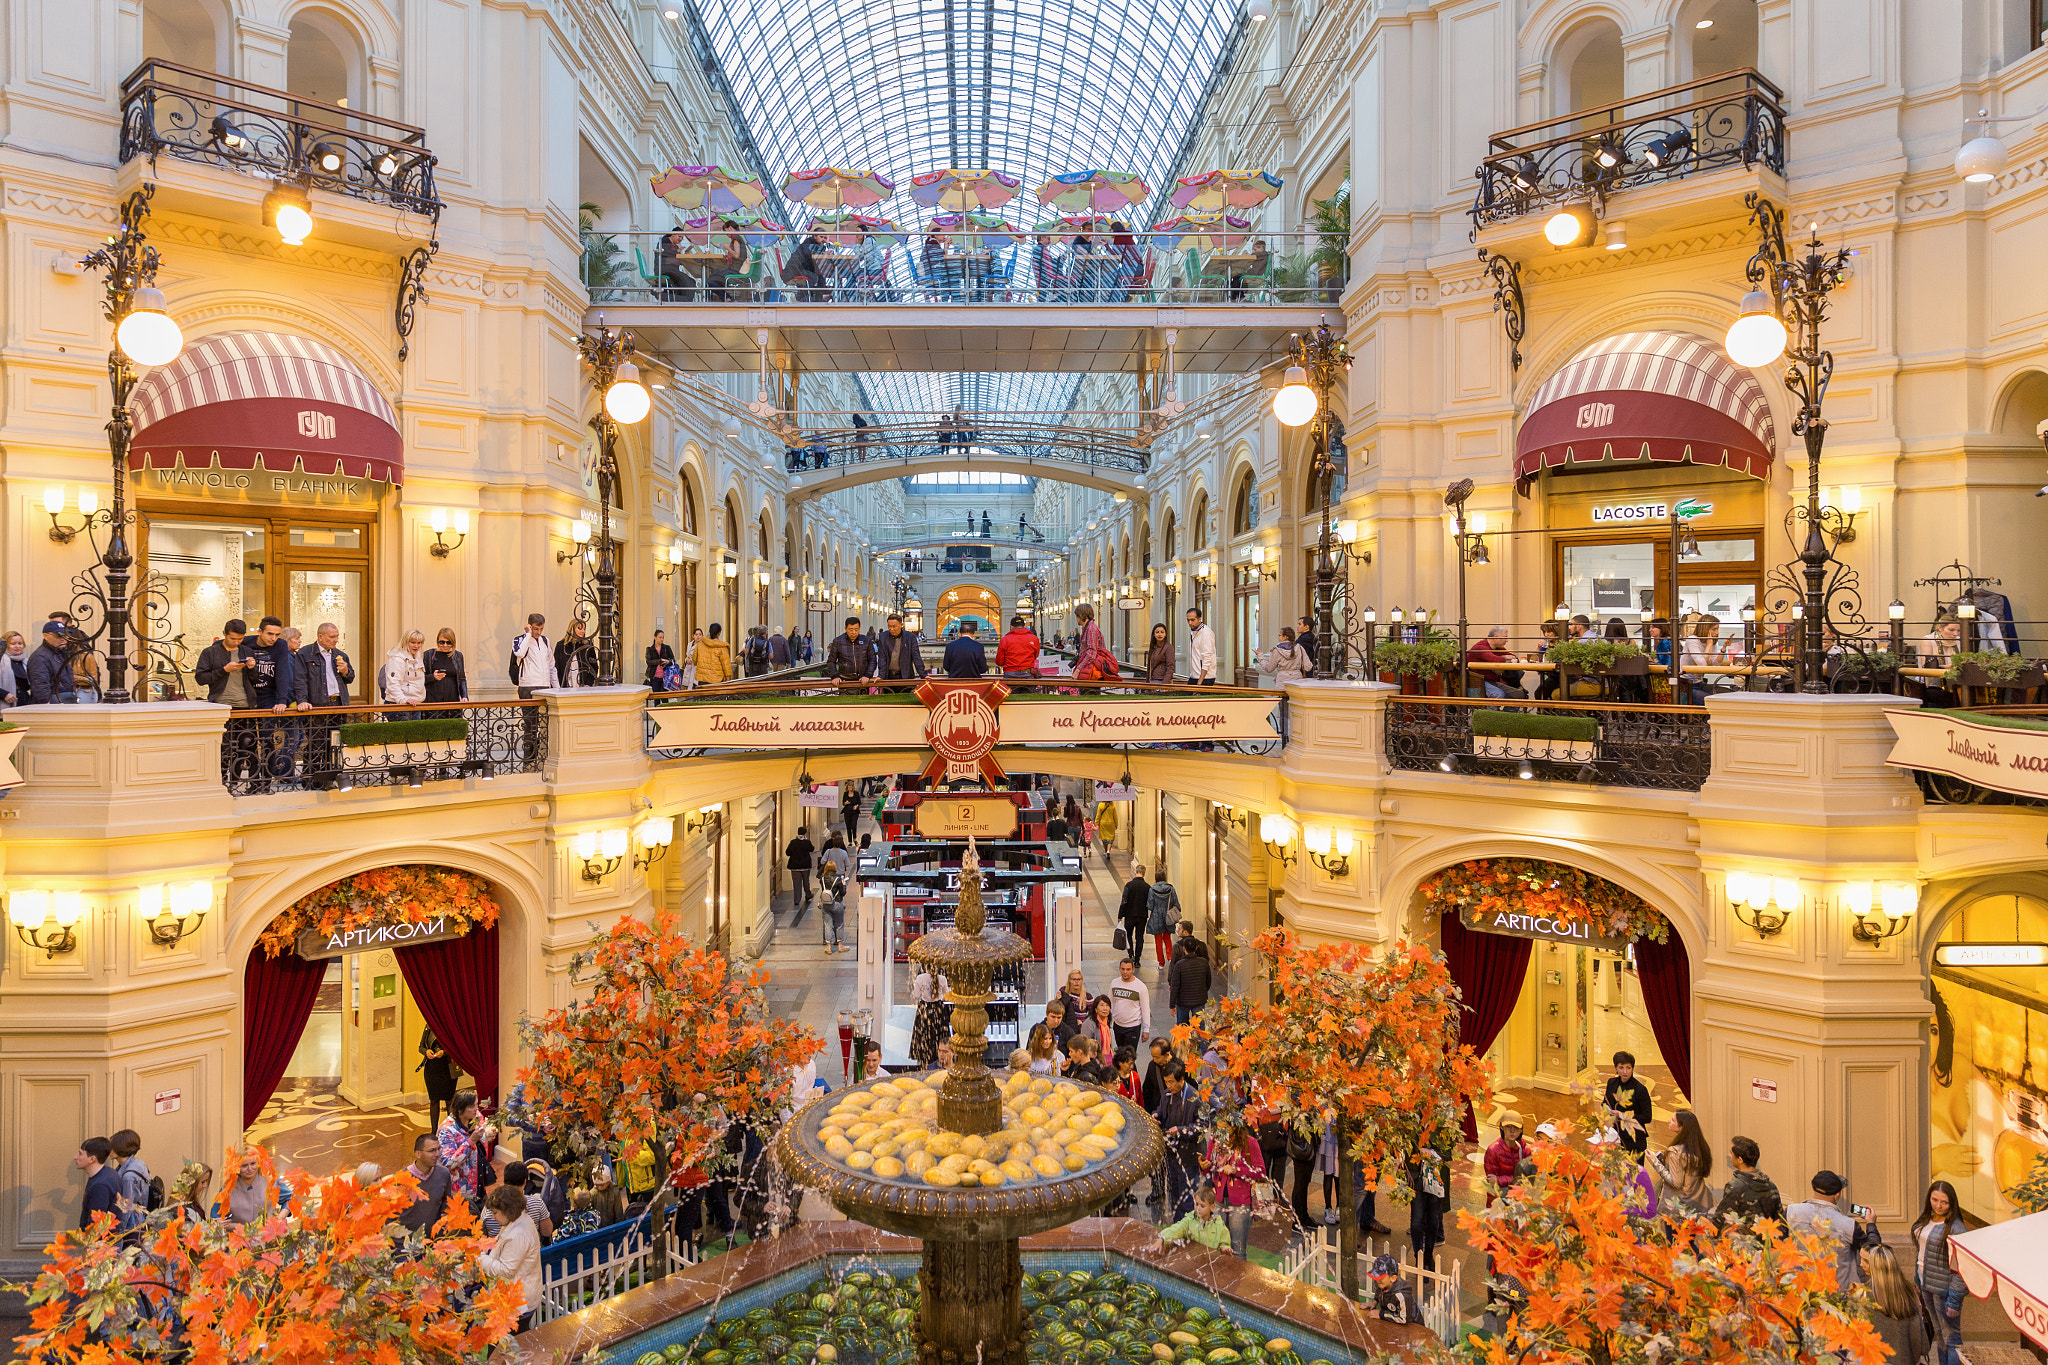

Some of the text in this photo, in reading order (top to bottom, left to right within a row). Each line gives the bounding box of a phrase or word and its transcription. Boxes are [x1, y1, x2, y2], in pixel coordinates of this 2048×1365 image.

[159, 469, 358, 496] MANOLO BLAHNIK
[1594, 504, 1665, 520] LACOSTE
[709, 713, 865, 732] Главный магазин
[1052, 710, 1227, 733] на Красной площади
[934, 741, 992, 761] КРАСНАЯ ПЛОЩАДЬ
[1946, 729, 2000, 766] Главный
[951, 763, 975, 774] GUM
[962, 808, 970, 819] 2
[326, 918, 444, 950] АРТИКОЛИ
[1493, 912, 1589, 939] ARTICOLI
[1113, 989, 1133, 998] FREDDY
[2013, 1295, 2048, 1335] BOS
